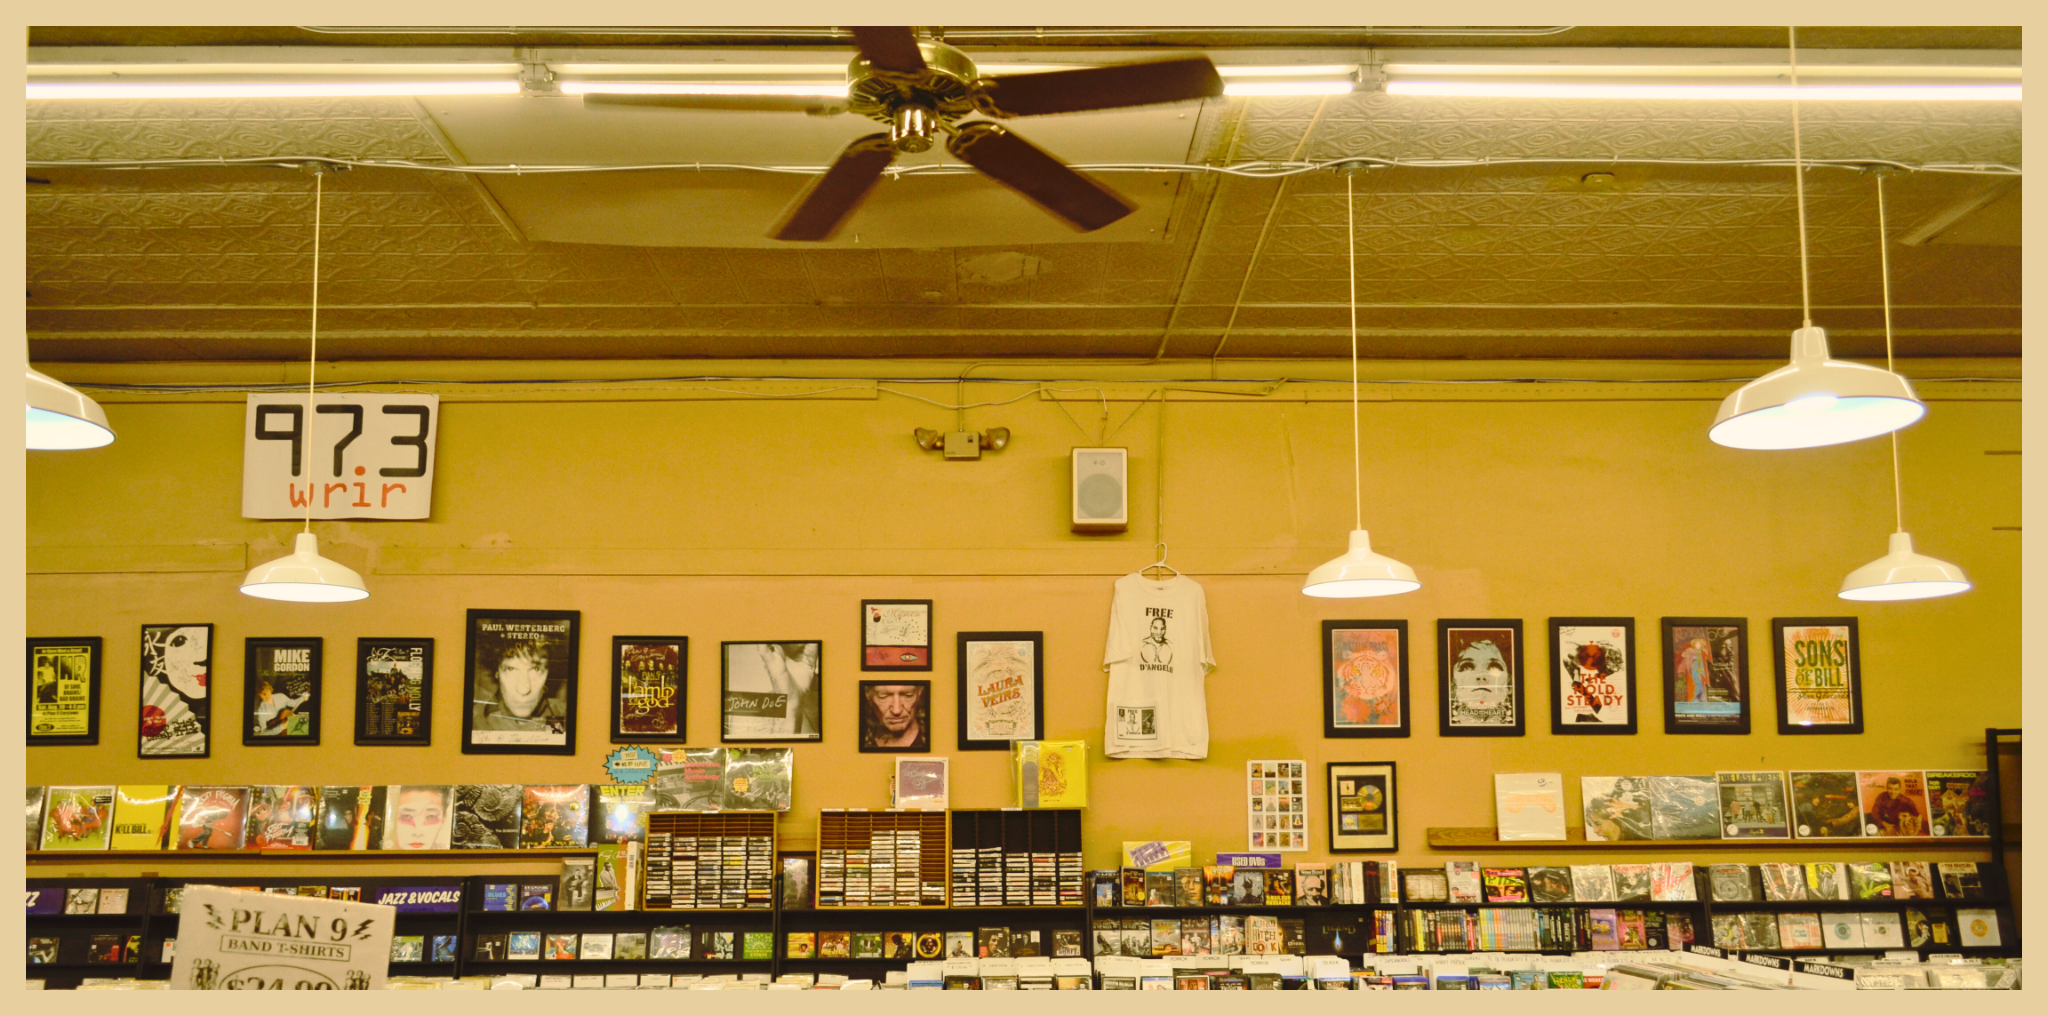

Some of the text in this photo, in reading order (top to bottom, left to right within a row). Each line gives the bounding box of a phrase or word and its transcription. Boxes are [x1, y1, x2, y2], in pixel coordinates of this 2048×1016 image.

[255, 403, 431, 478] 97.3
[289, 481, 407, 509] wrir
[1145, 607, 1174, 619] FREE
[482, 623, 565, 632] PAUL WESTERBERG
[506, 632, 540, 640] STEREO
[274, 649, 310, 663] MIKE
[1794, 639, 1845, 667] SONS
[274, 663, 310, 672] GORDON
[1139, 663, 1173, 673] D'ANGELO
[1814, 667, 1844, 687] BILL
[977, 675, 1024, 696] LAURA
[1566, 673, 1624, 706] THE HOLD STEADY
[981, 687, 1021, 708] VEIRS
[728, 697, 759, 712] JOHN
[684, 773, 721, 781] Anthology
[1736, 773, 1756, 781] LAST
[1757, 773, 1780, 781] POETS
[600, 785, 646, 797] ENTER
[115, 823, 147, 834] KILL BILL
[1231, 856, 1266, 866] USED DVDs
[378, 892, 407, 905] JAZZ
[229, 908, 348, 942] PLAN 9
[1322, 925, 1356, 935] LEGEND
[1252, 928, 1276, 941] HITCH
[227, 938, 345, 959] BAND T-SHIRTS
[1690, 945, 1721, 958] MARKDOWNS
[1745, 953, 1780, 968] MARKDOWNS
[1803, 963, 1844, 978] MARKDOWNS
